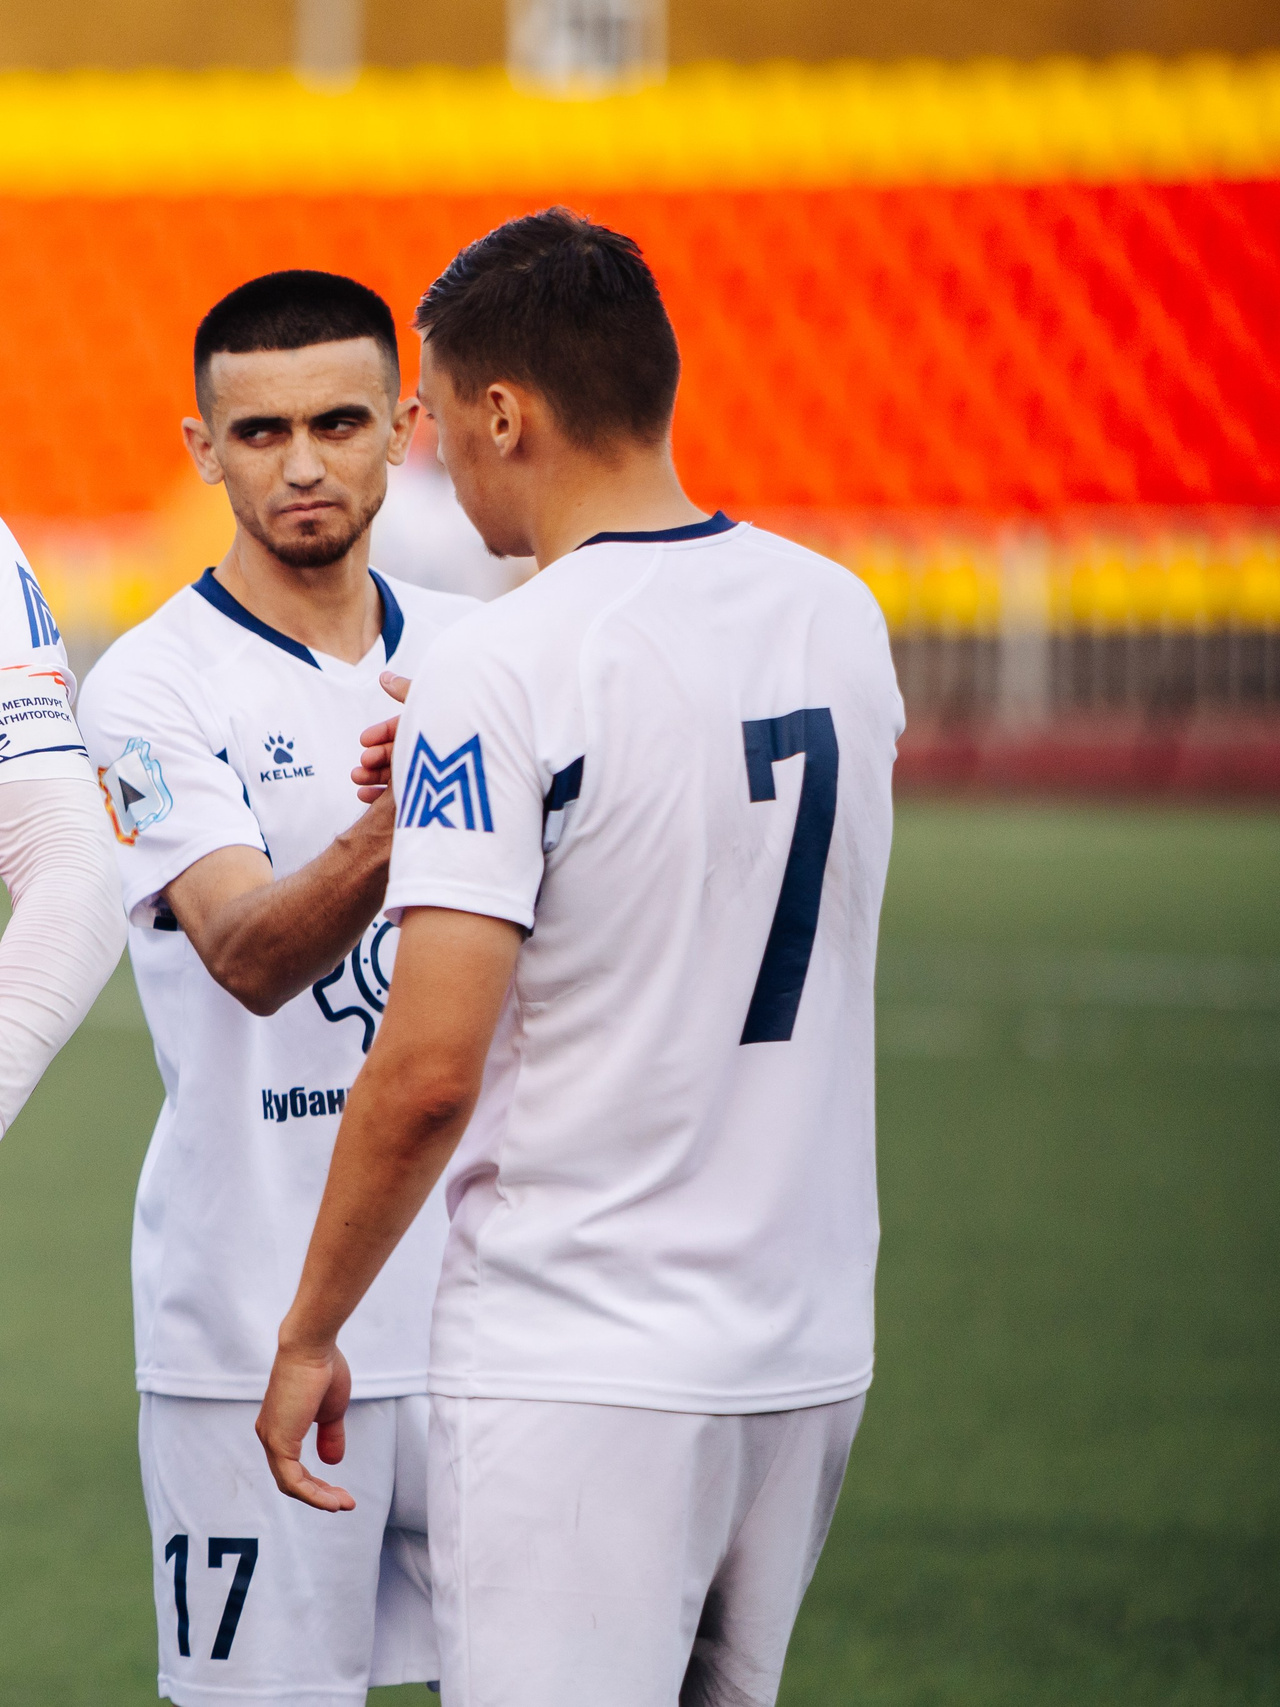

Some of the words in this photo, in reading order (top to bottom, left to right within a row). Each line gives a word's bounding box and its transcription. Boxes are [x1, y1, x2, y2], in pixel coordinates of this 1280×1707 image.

[2, 697, 63, 711] МЕТАЛЛУРГ
[260, 765, 315, 783] KELME
[739, 707, 839, 1046] 7
[261, 1086, 351, 1123] Кубан
[165, 1534, 259, 1660] 17
